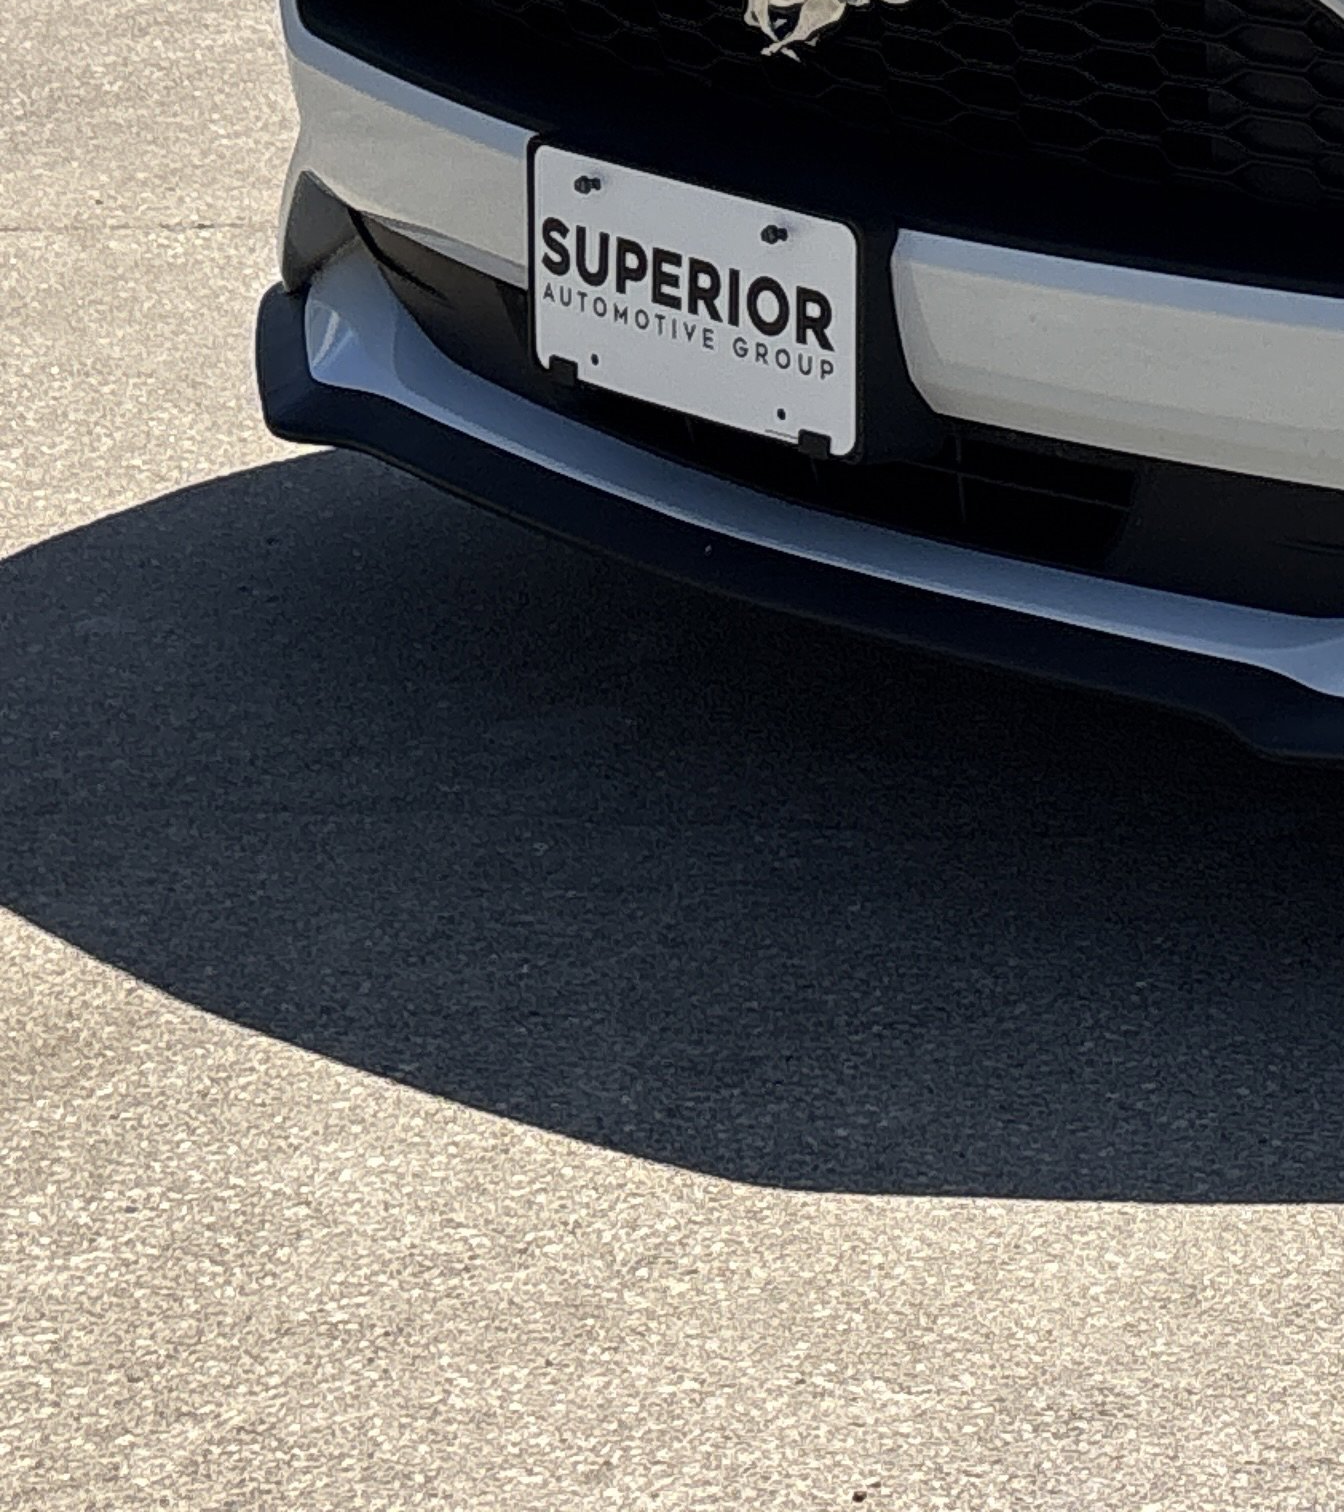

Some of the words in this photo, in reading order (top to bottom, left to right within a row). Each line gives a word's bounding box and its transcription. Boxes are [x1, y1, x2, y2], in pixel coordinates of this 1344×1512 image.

[541, 216, 835, 352] SUPERIOR
[542, 282, 715, 351] AUTOMOTIVE
[733, 336, 835, 380] GROUP
